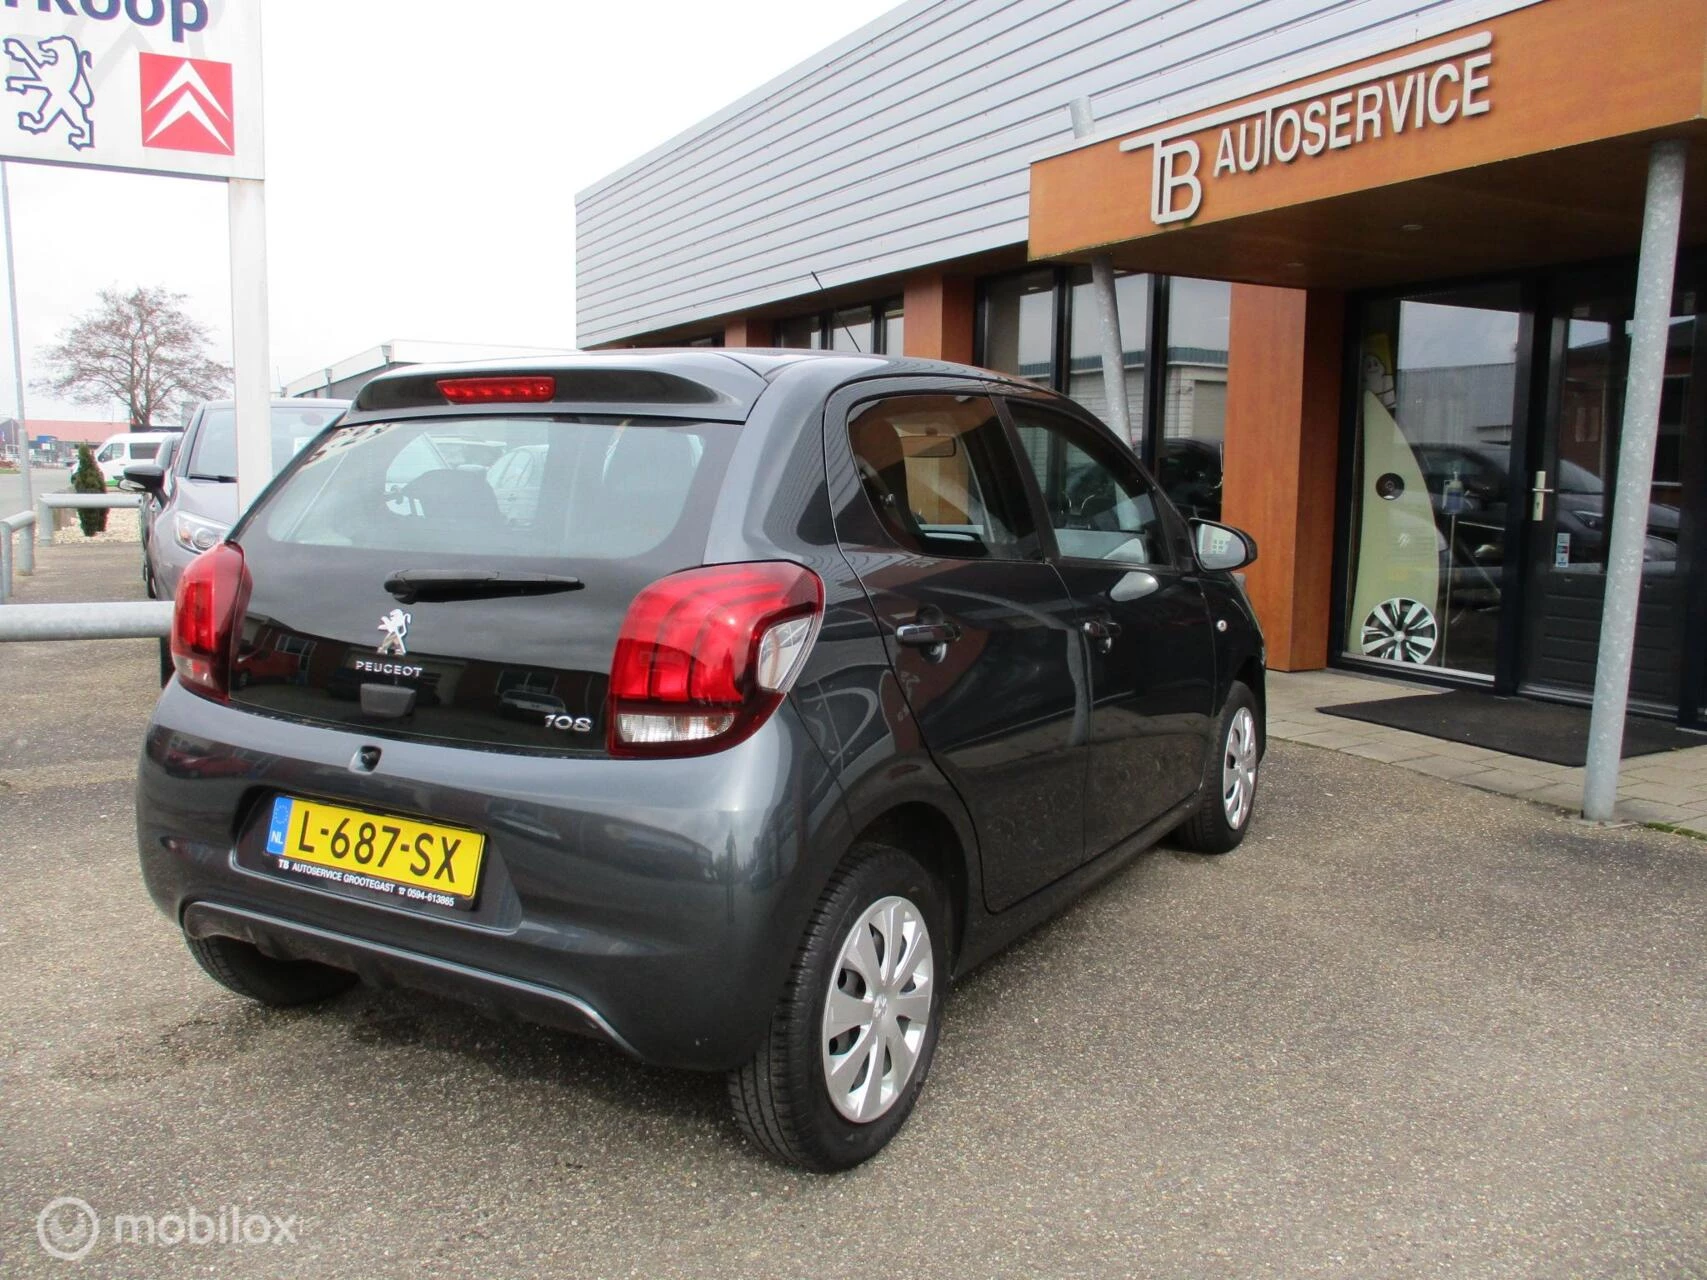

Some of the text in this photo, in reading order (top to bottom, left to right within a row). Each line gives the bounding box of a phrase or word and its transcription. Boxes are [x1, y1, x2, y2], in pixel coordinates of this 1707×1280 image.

[1119, 52, 1492, 224] TB AUTOSERVICE
[355, 661, 423, 678] PEUGEOT
[544, 714, 592, 732] 108
[270, 810, 462, 883] NL L-687-SX
[278, 858, 290, 870] TB
[292, 862, 342, 881] AUTOSERVICE
[343, 873, 396, 894] GROOTEGAST
